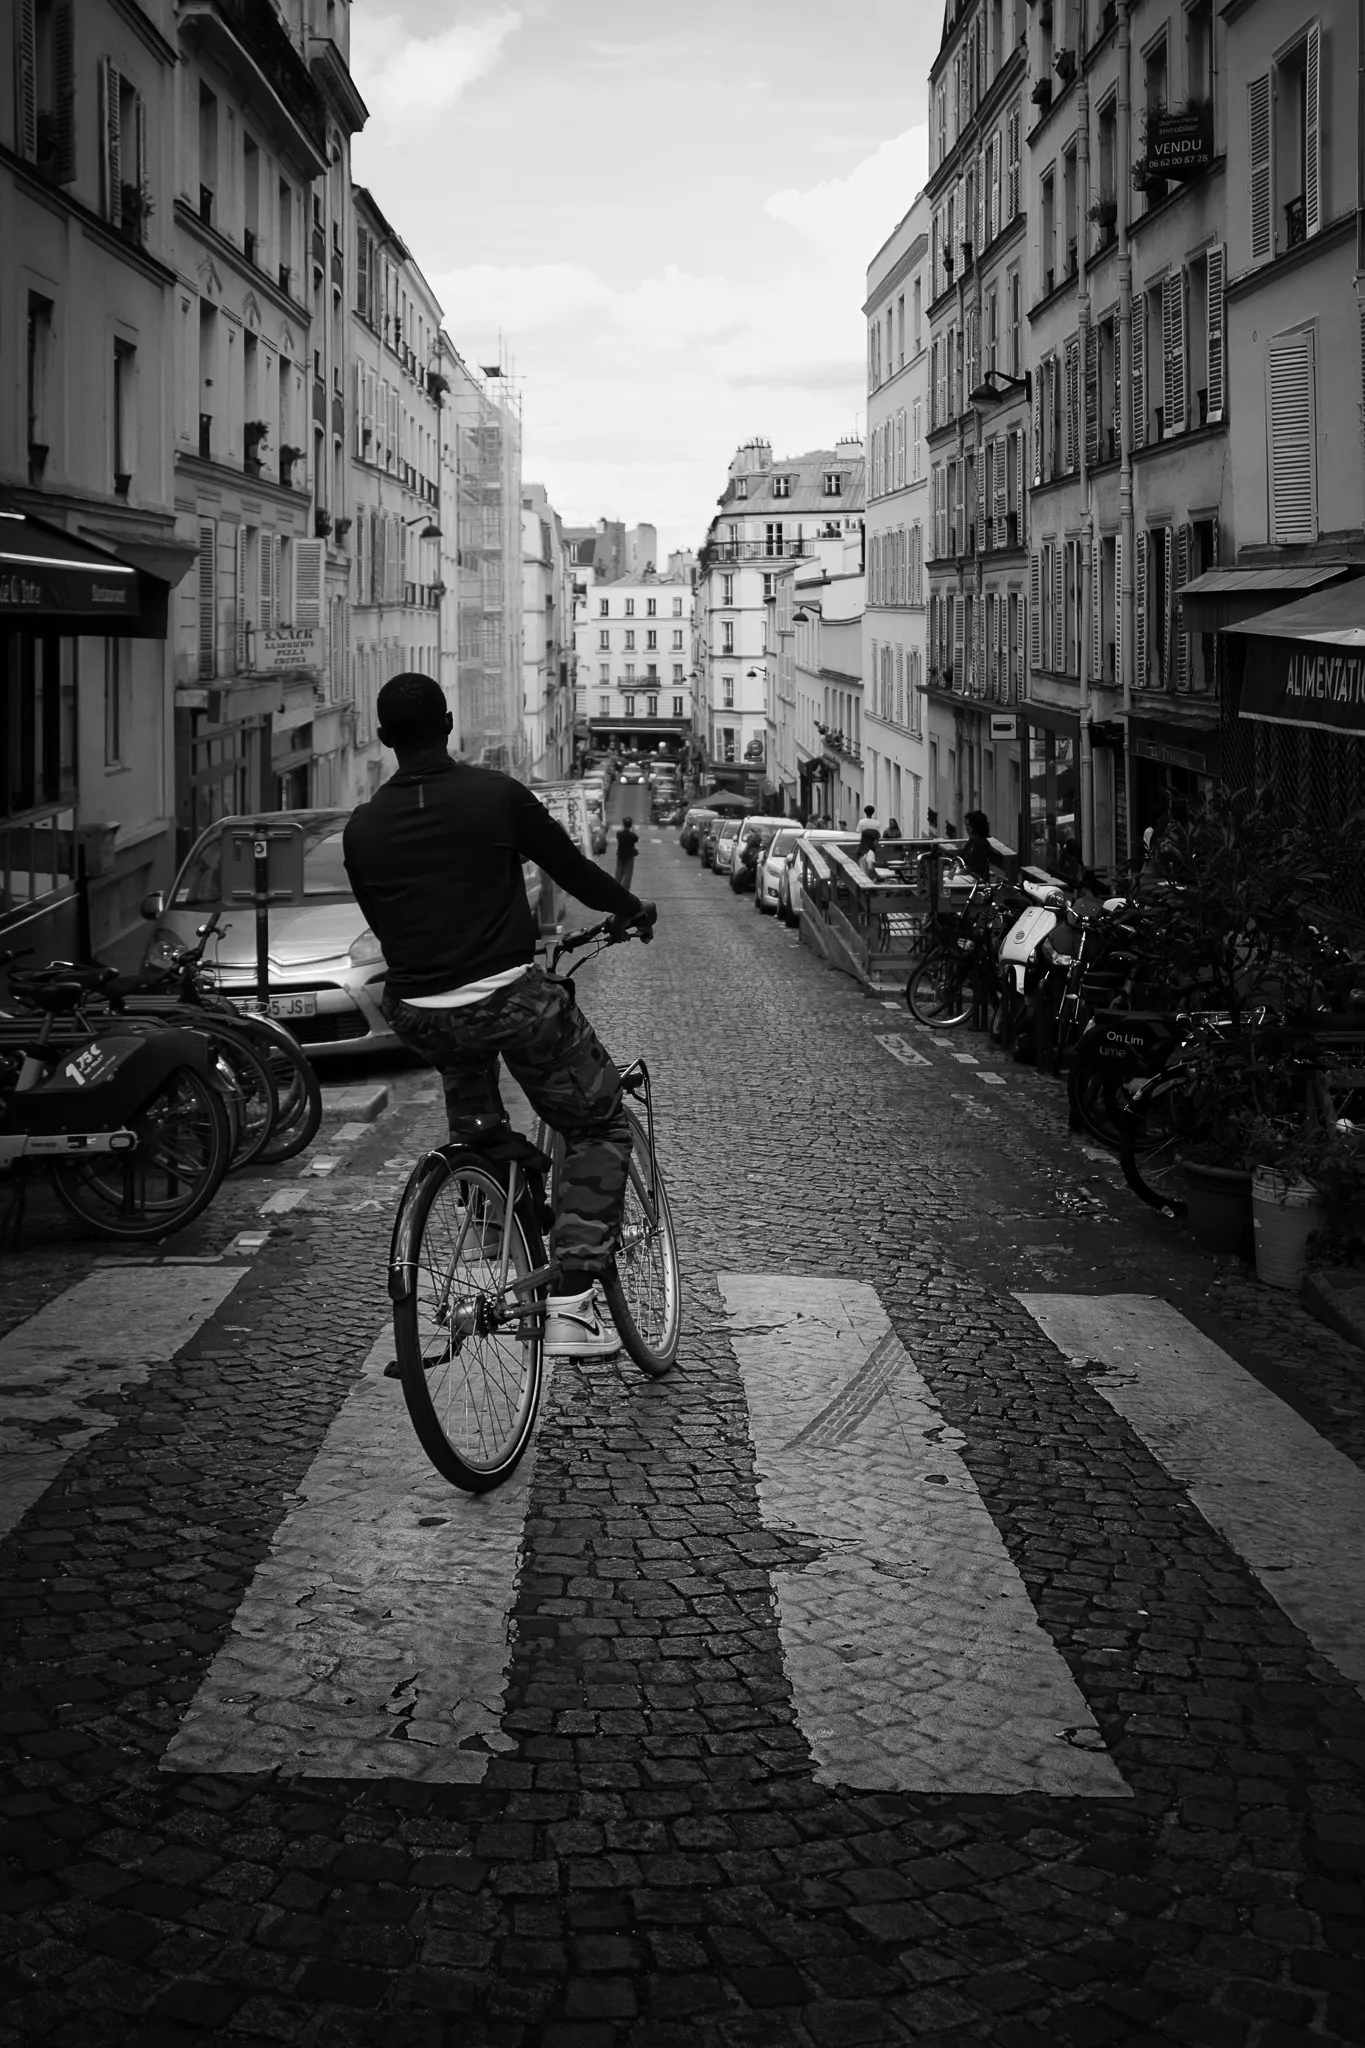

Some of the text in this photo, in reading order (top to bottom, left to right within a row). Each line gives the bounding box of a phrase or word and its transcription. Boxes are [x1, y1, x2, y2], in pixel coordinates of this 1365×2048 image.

[1158, 124, 1199, 135] Immobilier
[1154, 138, 1202, 156] VENDU
[1148, 153, 1208, 168] 06 62 00 87 28
[264, 628, 314, 641] SNACK
[1106, 1030, 1123, 1043] On
[1099, 1045, 1128, 1058] Lime
